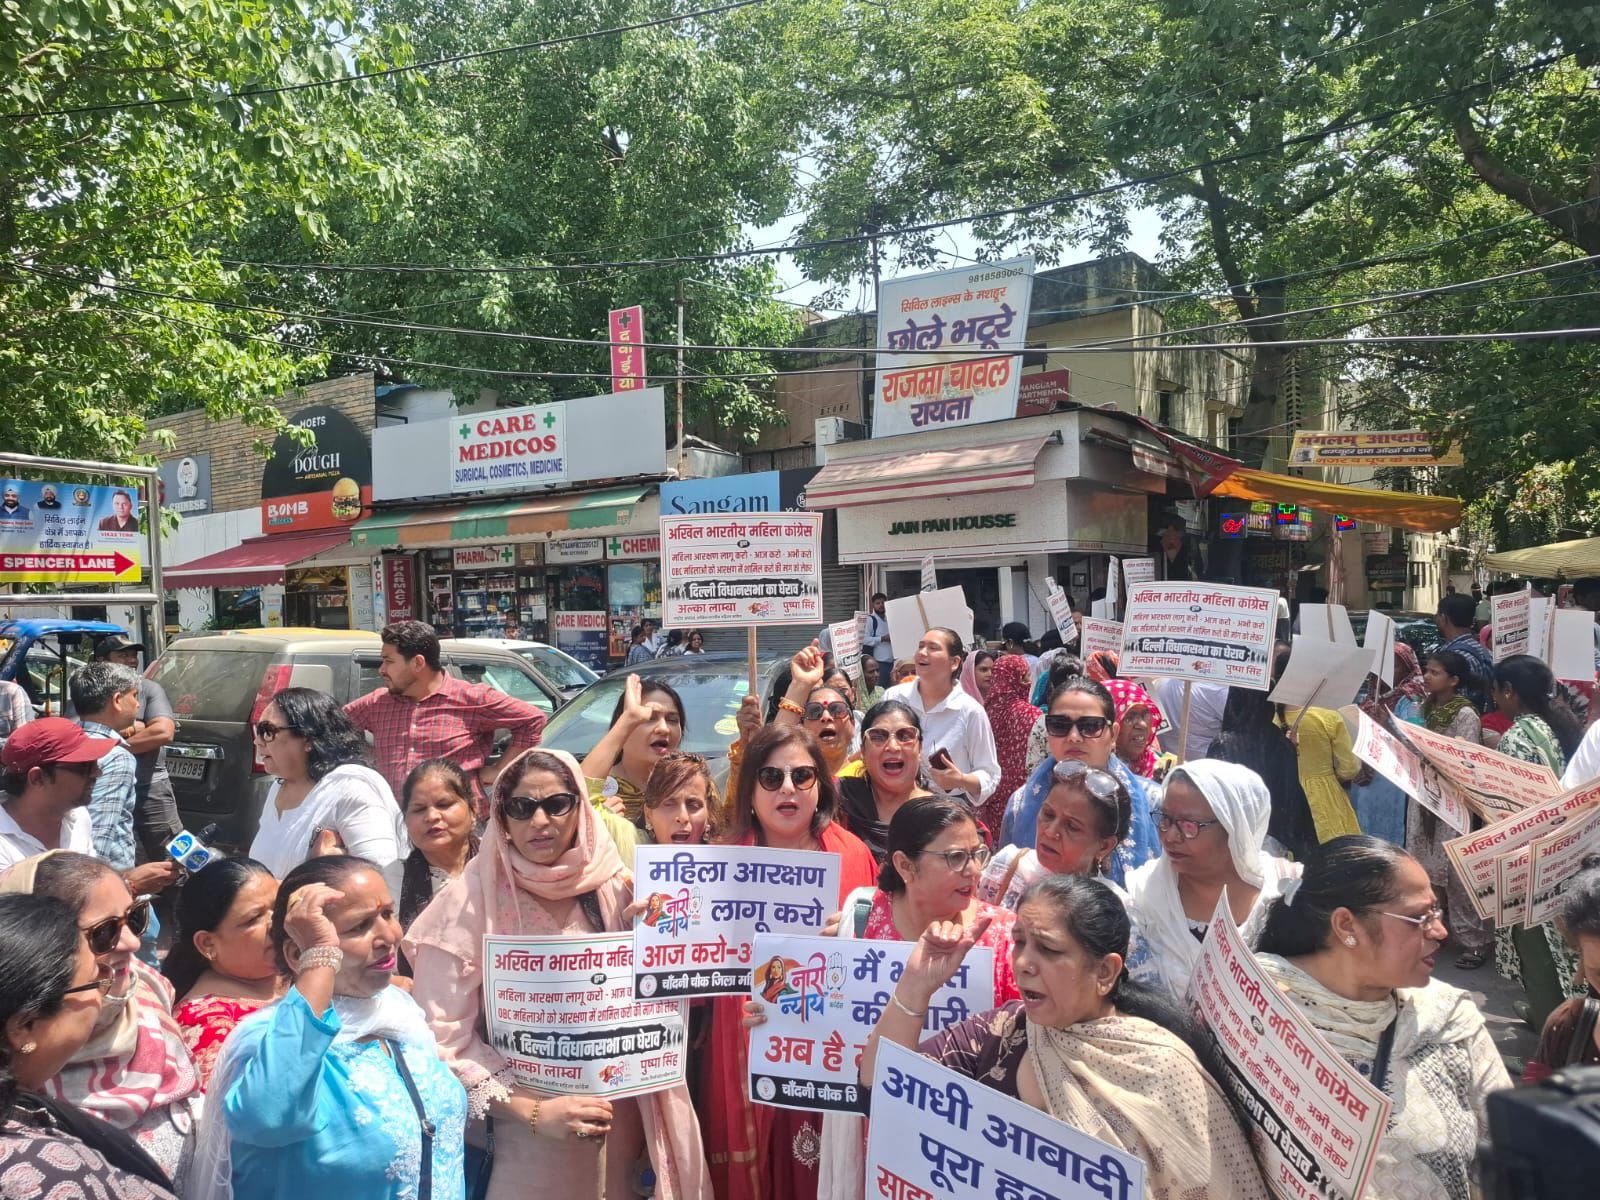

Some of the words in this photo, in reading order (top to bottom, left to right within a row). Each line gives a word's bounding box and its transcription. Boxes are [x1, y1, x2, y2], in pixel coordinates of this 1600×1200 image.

[901, 298, 929, 313] सिविल
[931, 293, 961, 308] लाइन्स
[963, 290, 973, 302] के
[976, 286, 1008, 303] मशहूर
[887, 313, 947, 354] छोले
[950, 303, 1017, 350] भटूरे
[882, 366, 945, 403] राजमा
[949, 357, 1014, 392] चावल
[911, 396, 974, 427] रायता
[477, 413, 536, 437] CARE
[459, 434, 557, 463] MEDICOS
[294, 452, 341, 474] DOUGH
[455, 467, 489, 483] SURGICAL,
[489, 461, 529, 479] COSMETICS,
[530, 458, 563, 475] MEDICINE
[268, 501, 309, 517] BOMB
[670, 495, 769, 514] Sangam
[64, 529, 87, 537] आपका
[669, 524, 703, 540] अखिल
[707, 523, 746, 538] भारतीय
[748, 522, 782, 538] महिला
[785, 521, 813, 537] कांग्रेस
[888, 520, 920, 536] JAIN
[921, 519, 951, 534] PAN
[952, 513, 1016, 532] HOUSSE
[40, 538, 61, 549] हार्दिक
[62, 540, 83, 549] स्वागत
[672, 552, 693, 562] महिला
[694, 551, 719, 561] आरक्षण
[720, 551, 735, 562] लागू
[735, 549, 748, 560] करो
[754, 550, 767, 559] आज
[769, 549, 781, 559] करो
[787, 548, 799, 559] अभी
[800, 548, 812, 559] करो
[4, 557, 75, 568] SPENCER
[79, 558, 115, 569] LANE
[689, 582, 716, 599] दिल्ली
[718, 582, 764, 598] विधानसभा
[765, 583, 777, 596] का
[778, 580, 799, 596] घेराव
[1134, 589, 1162, 605] अखिल
[1164, 589, 1200, 604] भारतीय
[1202, 592, 1235, 608] महिला
[1238, 593, 1269, 611] कांग्रेस
[677, 602, 706, 614] अल्का
[709, 602, 737, 613] लाम्बा
[783, 601, 800, 613] पुष्पा
[802, 598, 816, 610] सिंह
[555, 615, 576, 627] CARE
[1142, 639, 1165, 653] दिल्ली
[1166, 640, 1209, 656] विधानसभा
[1211, 646, 1222, 657] का
[1223, 644, 1246, 659] घेराव
[1467, 750, 1508, 772] महिला
[1510, 762, 1547, 785] कांग्रेस
[1460, 831, 1507, 857] अखिल
[1510, 807, 1560, 837] भारतीय
[1562, 786, 1600, 812] महिल
[1541, 832, 1581, 858] अखिल
[649, 852, 728, 884] महिला
[733, 862, 826, 888] आरक्षण
[666, 887, 690, 918] नारी
[711, 900, 771, 933] लागू
[774, 897, 824, 927] करो
[657, 915, 689, 938] न्याय
[494, 949, 544, 973] अखिल
[549, 947, 603, 972] भारतीय
[642, 942, 686, 968] आज
[853, 948, 886, 983] मैं
[661, 971, 689, 991] चाँदनी
[690, 972, 710, 988] चौक
[711, 971, 736, 987] जिला
[790, 952, 828, 996] नारी
[497, 987, 526, 1002] महिला
[528, 991, 563, 1004] आरक्षण
[565, 991, 586, 1006] लागू
[586, 987, 604, 1001] करो
[611, 986, 626, 999] आज
[780, 990, 828, 1022] न्याय
[851, 990, 891, 1026] की
[498, 1007, 512, 1020] OBC
[546, 1009, 557, 1024] को
[558, 1011, 587, 1025] आरक्षण
[588, 1007, 598, 1022] में
[598, 1005, 620, 1020] शामिल
[620, 1003, 632, 1019] करो
[633, 1001, 642, 1016] की
[520, 1033, 556, 1057] दिल्ली
[558, 1034, 620, 1058] विधानसभा
[621, 1035, 635, 1051] का
[637, 1028, 661, 1049] घेराव
[764, 1035, 815, 1066] अब
[822, 1030, 846, 1072] है
[1229, 956, 1270, 1017] भारतीय
[1268, 1007, 1316, 1070] महिला
[1314, 1058, 1370, 1122] कांग्रेस
[506, 1057, 541, 1076] अल्का
[544, 1064, 582, 1080] लाम्बा
[640, 1057, 661, 1075] पुष्पा
[662, 1051, 679, 1067] सिंह
[781, 1079, 816, 1100] चाँदनी
[817, 1083, 842, 1102] चौक
[881, 1066, 973, 1131] आधी
[981, 1114, 1133, 1200] आबादी
[1263, 1110, 1280, 1141] का
[1279, 1129, 1313, 1177] घेराव
[918, 1132, 985, 1194] पूरा
